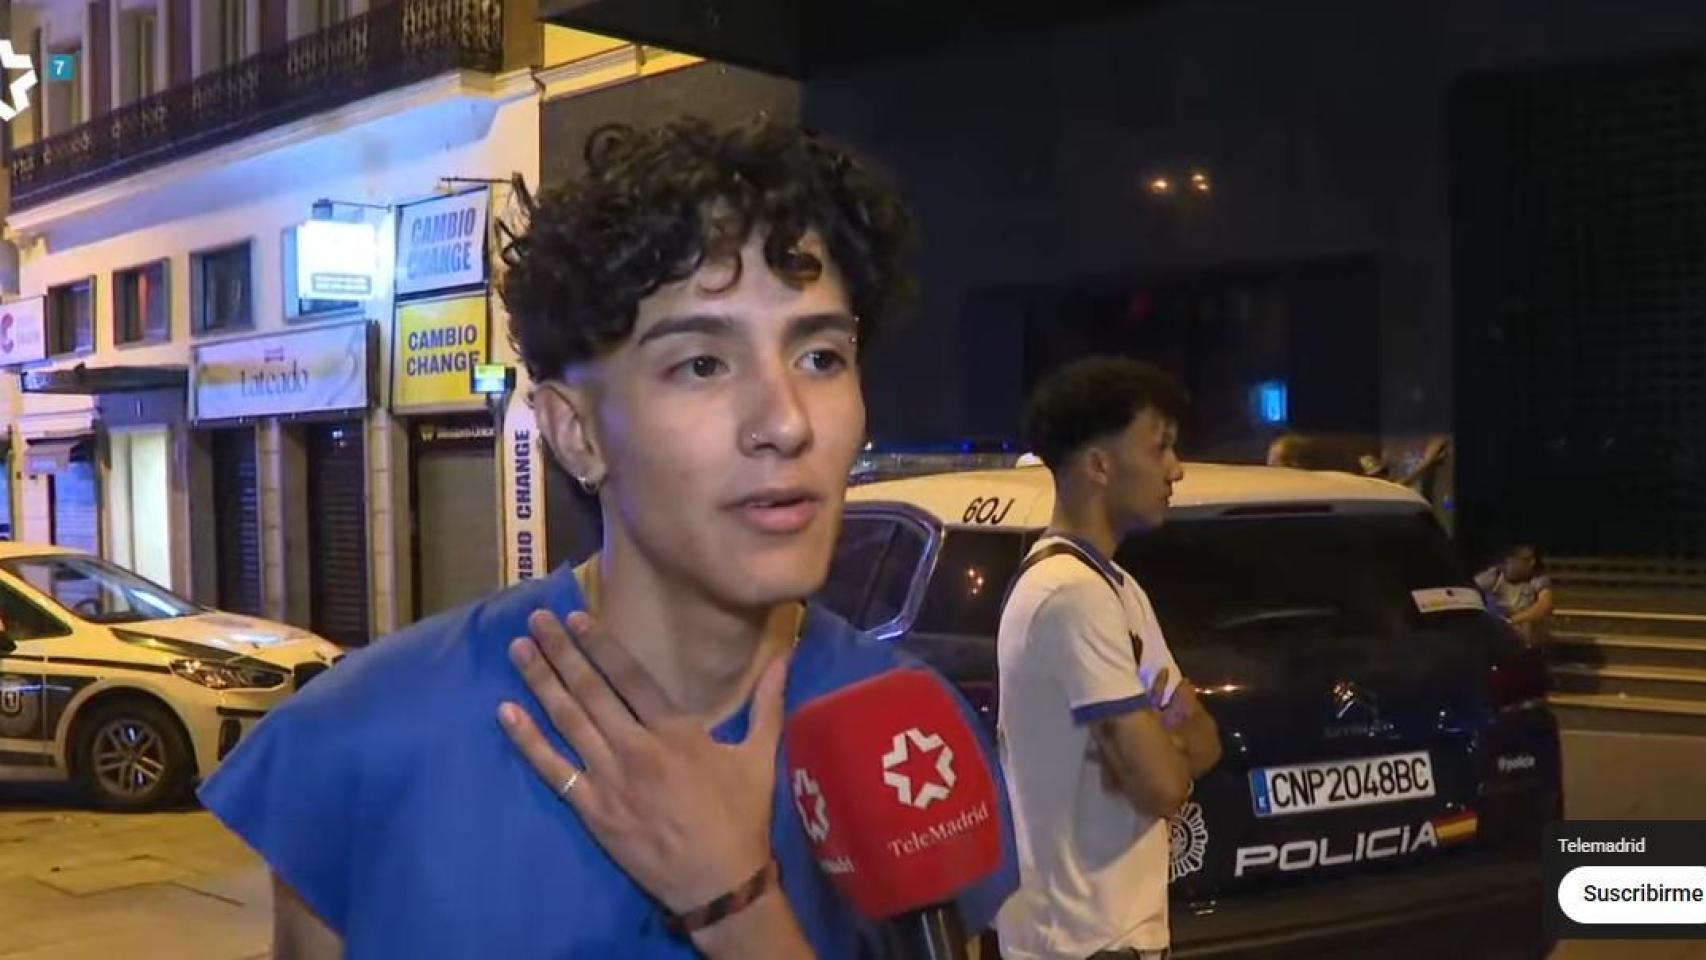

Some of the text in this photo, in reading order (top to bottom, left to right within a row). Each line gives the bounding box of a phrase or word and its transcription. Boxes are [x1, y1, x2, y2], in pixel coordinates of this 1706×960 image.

[411, 207, 476, 244] CAMBIO
[406, 240, 472, 280] CHANGE
[408, 324, 478, 351] CAMBIO
[406, 350, 479, 376] CHANGE
[515, 429, 532, 521] CHANGE
[1271, 758, 1430, 809] CNP2048BC
[887, 801, 990, 858] TeleMadrid
[1234, 821, 1438, 878] POLICIA
